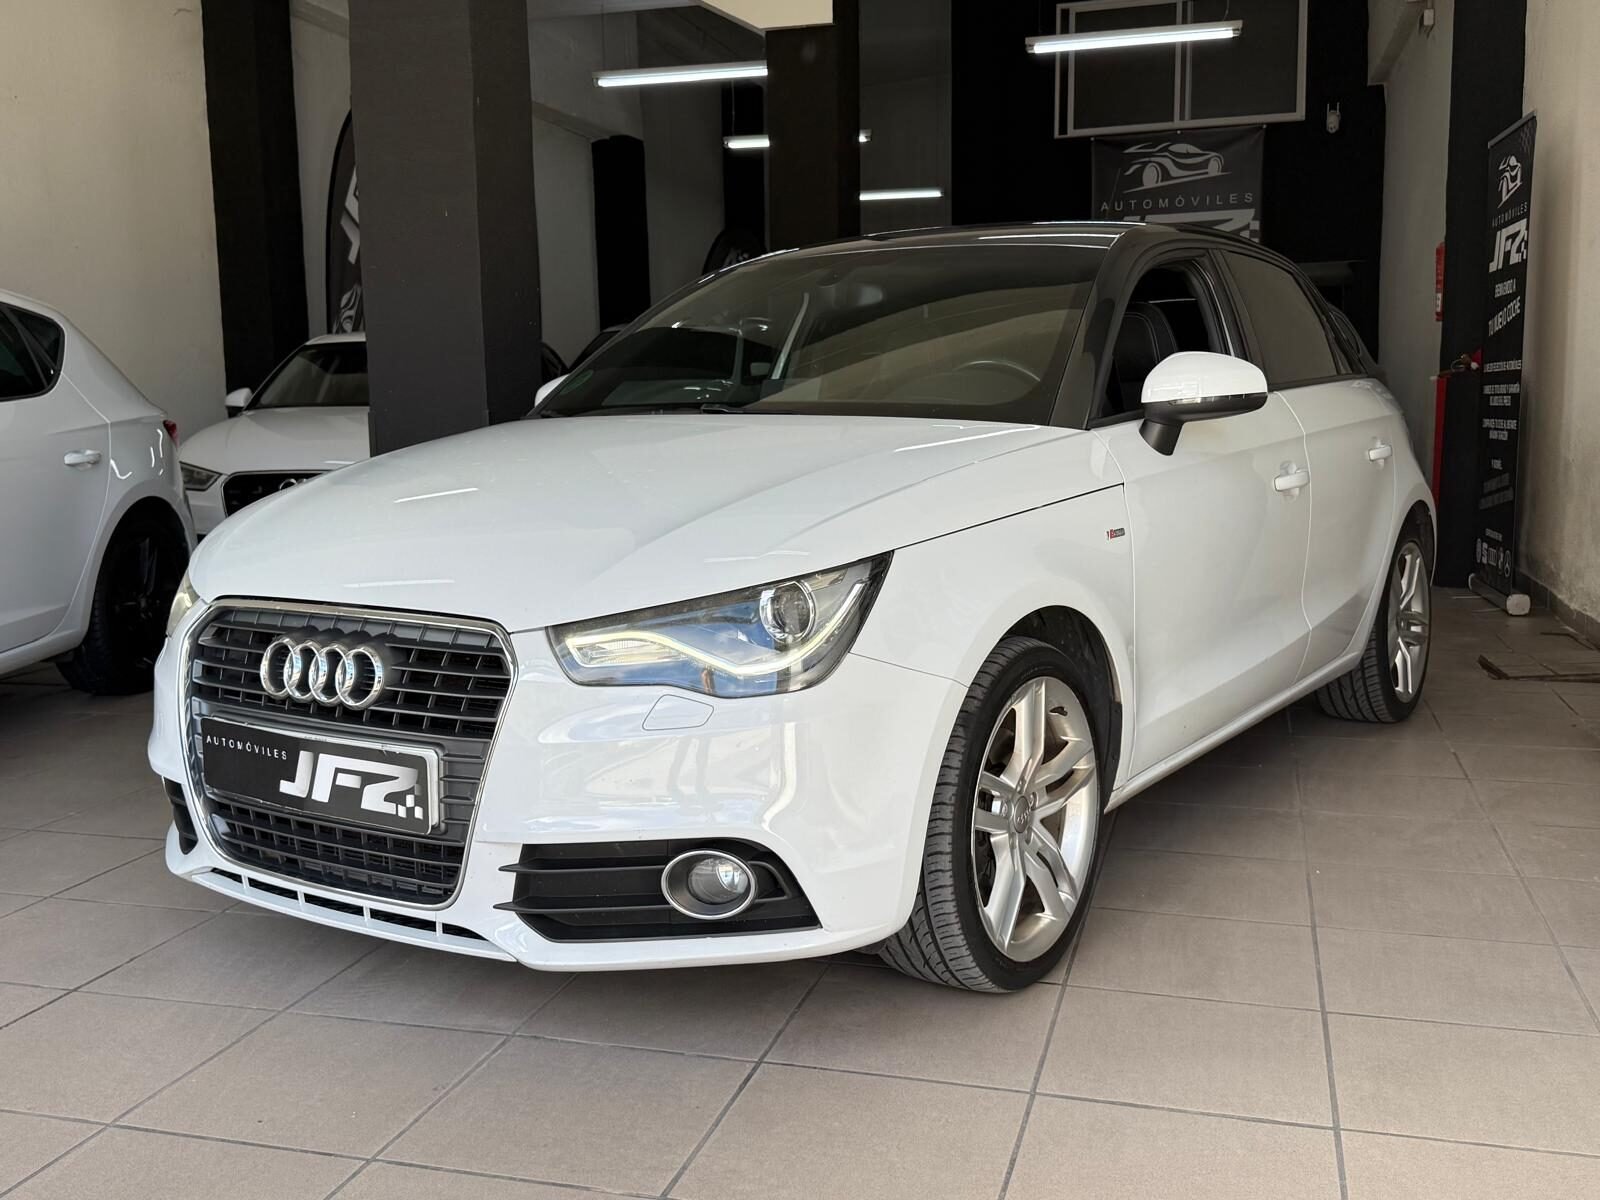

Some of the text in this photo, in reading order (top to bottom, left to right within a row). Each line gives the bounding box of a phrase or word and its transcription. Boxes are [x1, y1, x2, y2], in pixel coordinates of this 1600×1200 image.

[1101, 193, 1254, 212] AUTOMÓVILES
[1489, 218, 1527, 272] JFZ
[1507, 295, 1521, 322] COCHE
[206, 734, 287, 761] AUTOMÓVILES
[279, 750, 422, 819] JFZ
